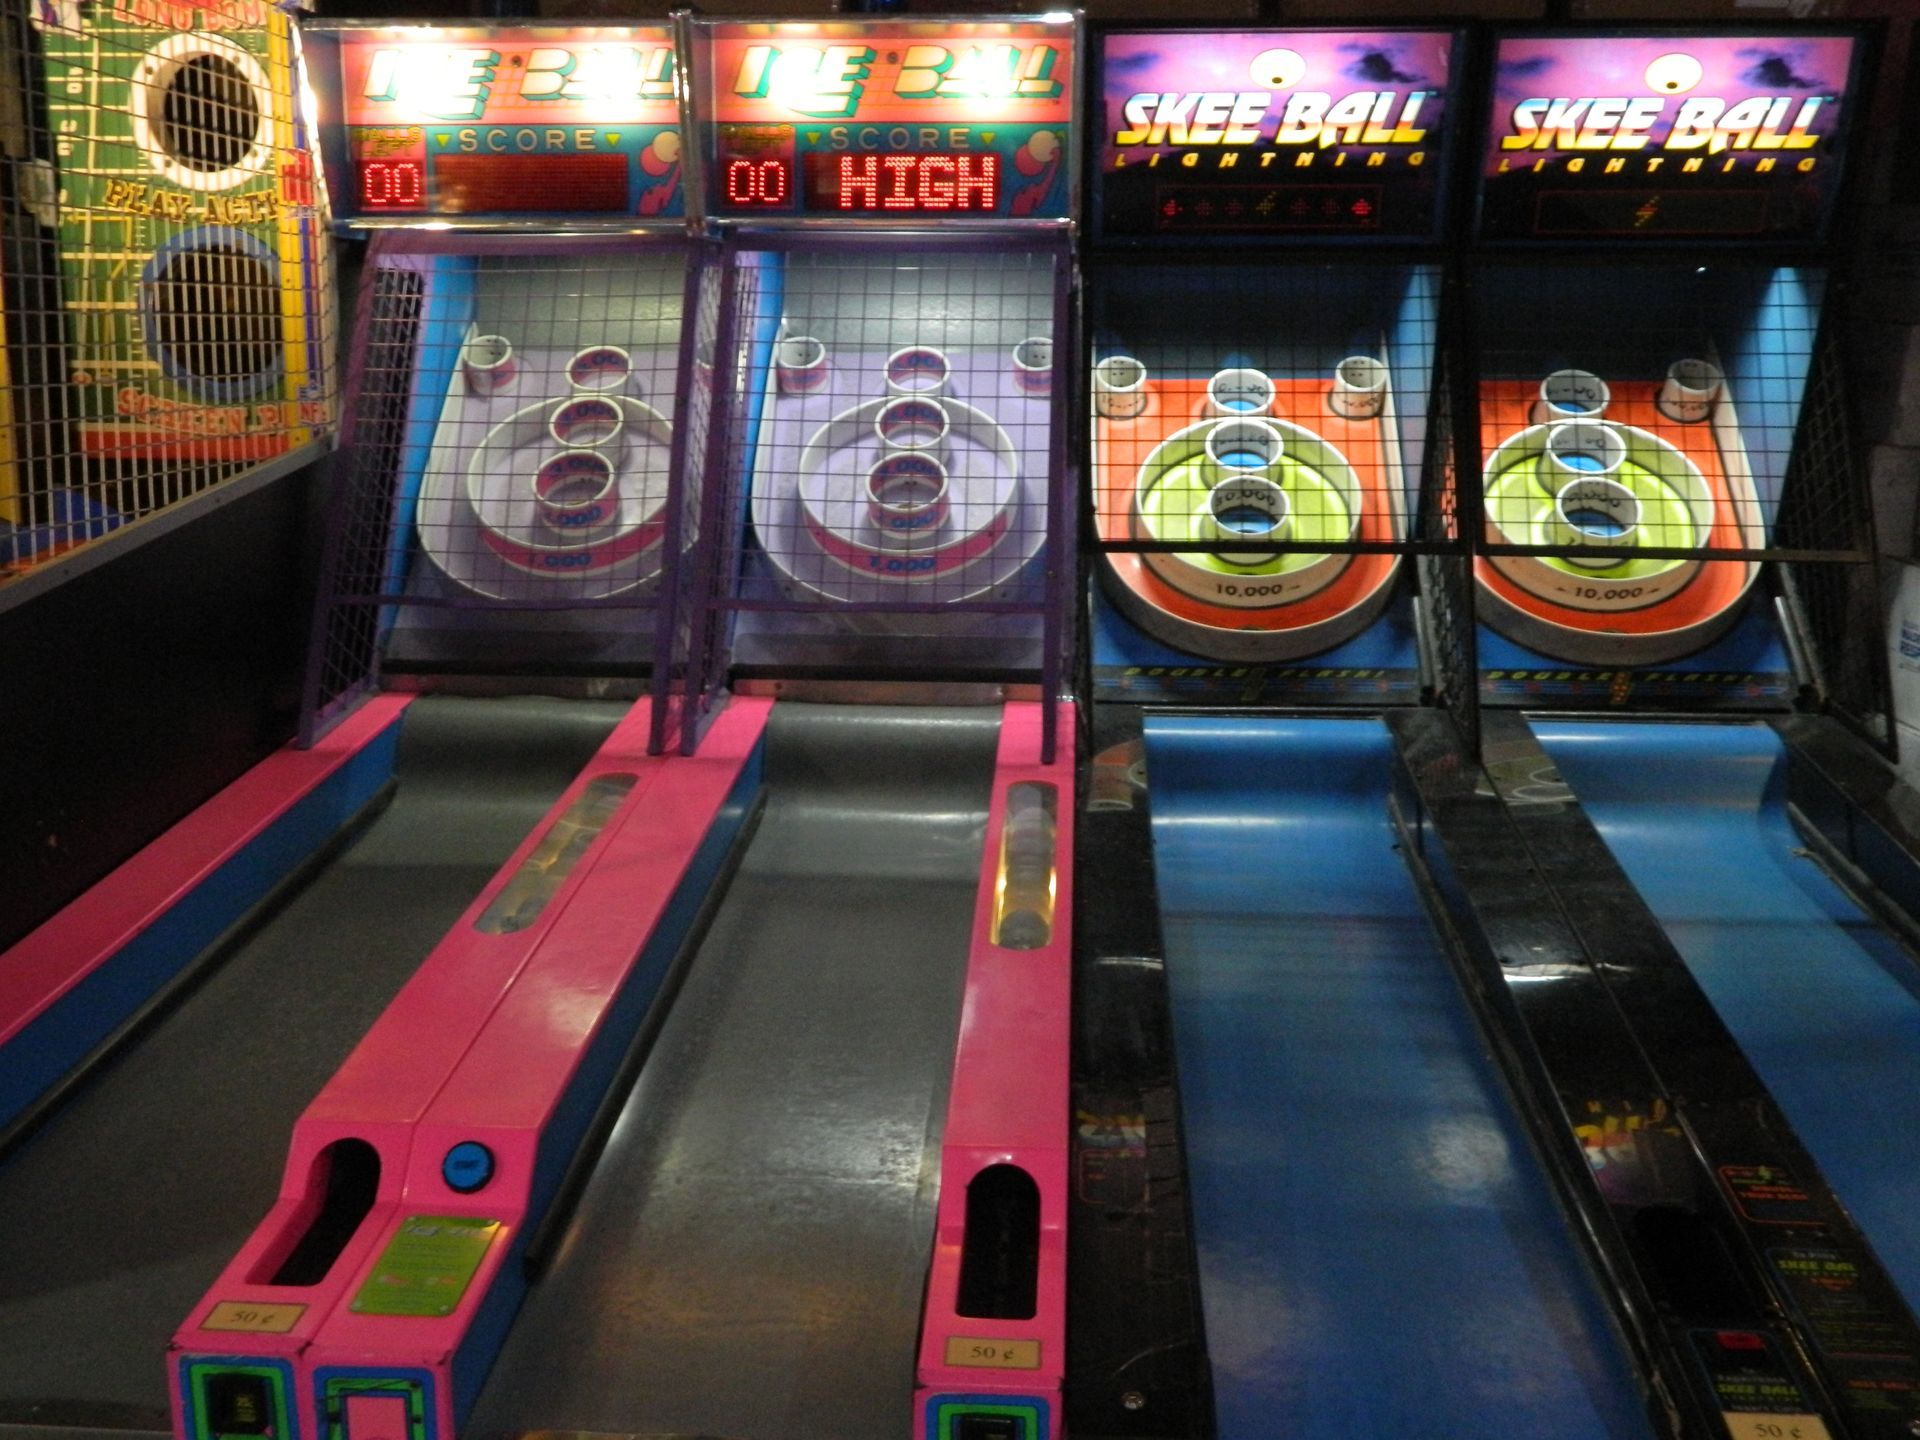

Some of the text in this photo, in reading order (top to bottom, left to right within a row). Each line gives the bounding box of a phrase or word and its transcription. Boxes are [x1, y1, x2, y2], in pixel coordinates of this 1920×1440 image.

[1116, 91, 1428, 150] SKEE BALL
[1502, 97, 1823, 156] SKEE BALL
[458, 129, 597, 151] SCORE
[830, 128, 971, 149] SCORE
[1114, 152, 1426, 168] LIGHTNING
[1497, 157, 1816, 174] LIGHTNING
[364, 163, 421, 203] 00
[729, 160, 785, 202] 00
[840, 155, 995, 209] HIGH
[106, 179, 193, 222] PLAY
[1216, 583, 1283, 598] 10,000
[1574, 586, 1644, 601] 10,000
[230, 1310, 258, 1323] 50
[970, 1346, 1015, 1362] 50 ¢
[1755, 1423, 1783, 1438] 50
